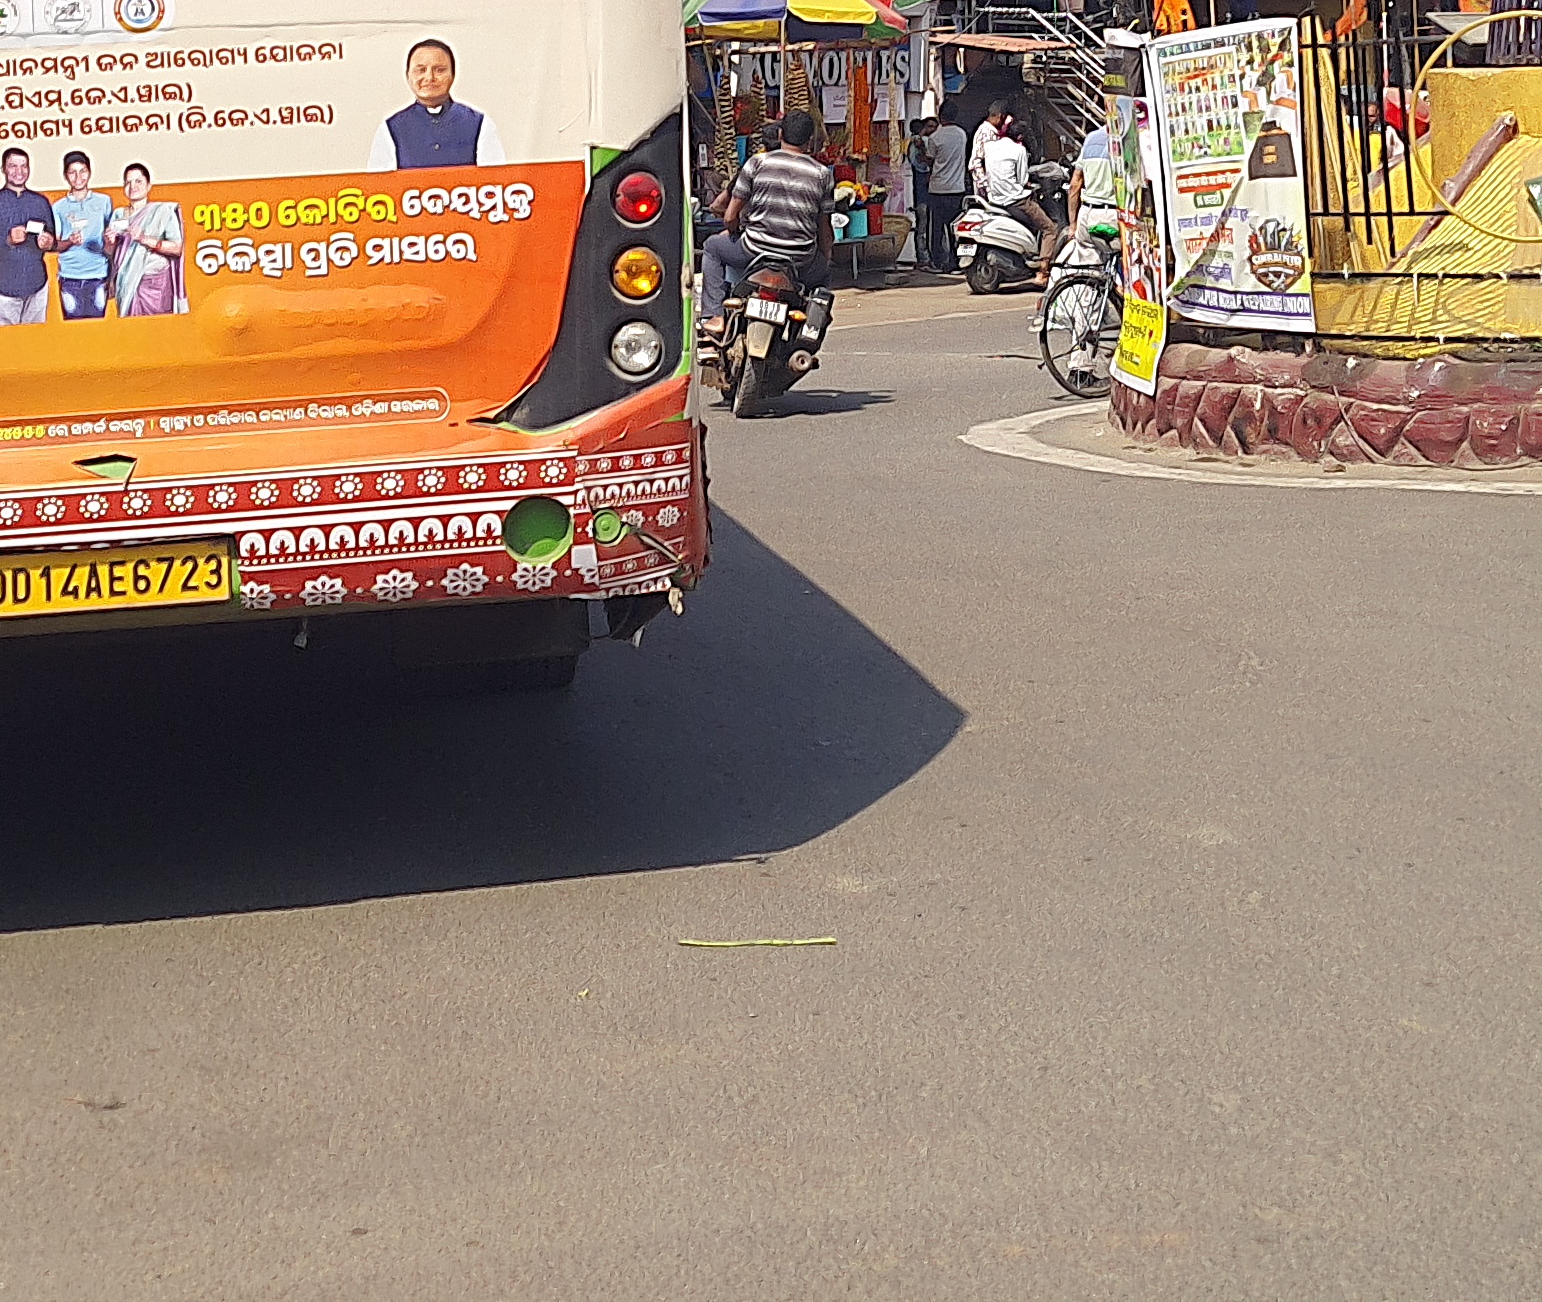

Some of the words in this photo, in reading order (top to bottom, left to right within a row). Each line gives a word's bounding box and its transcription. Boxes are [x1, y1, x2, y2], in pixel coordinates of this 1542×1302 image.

[96, 52, 139, 73] ଜନ
[145, 46, 248, 70] ଆରୋଗ୍ୟ
[255, 42, 344, 65] ଯୋଜନା
[80, 111, 171, 136] ଯୋଜନା
[277, 186, 398, 227] କୋଟିର
[300, 231, 359, 276] ପ୍ରତି
[365, 231, 478, 266] ମାସରେ
